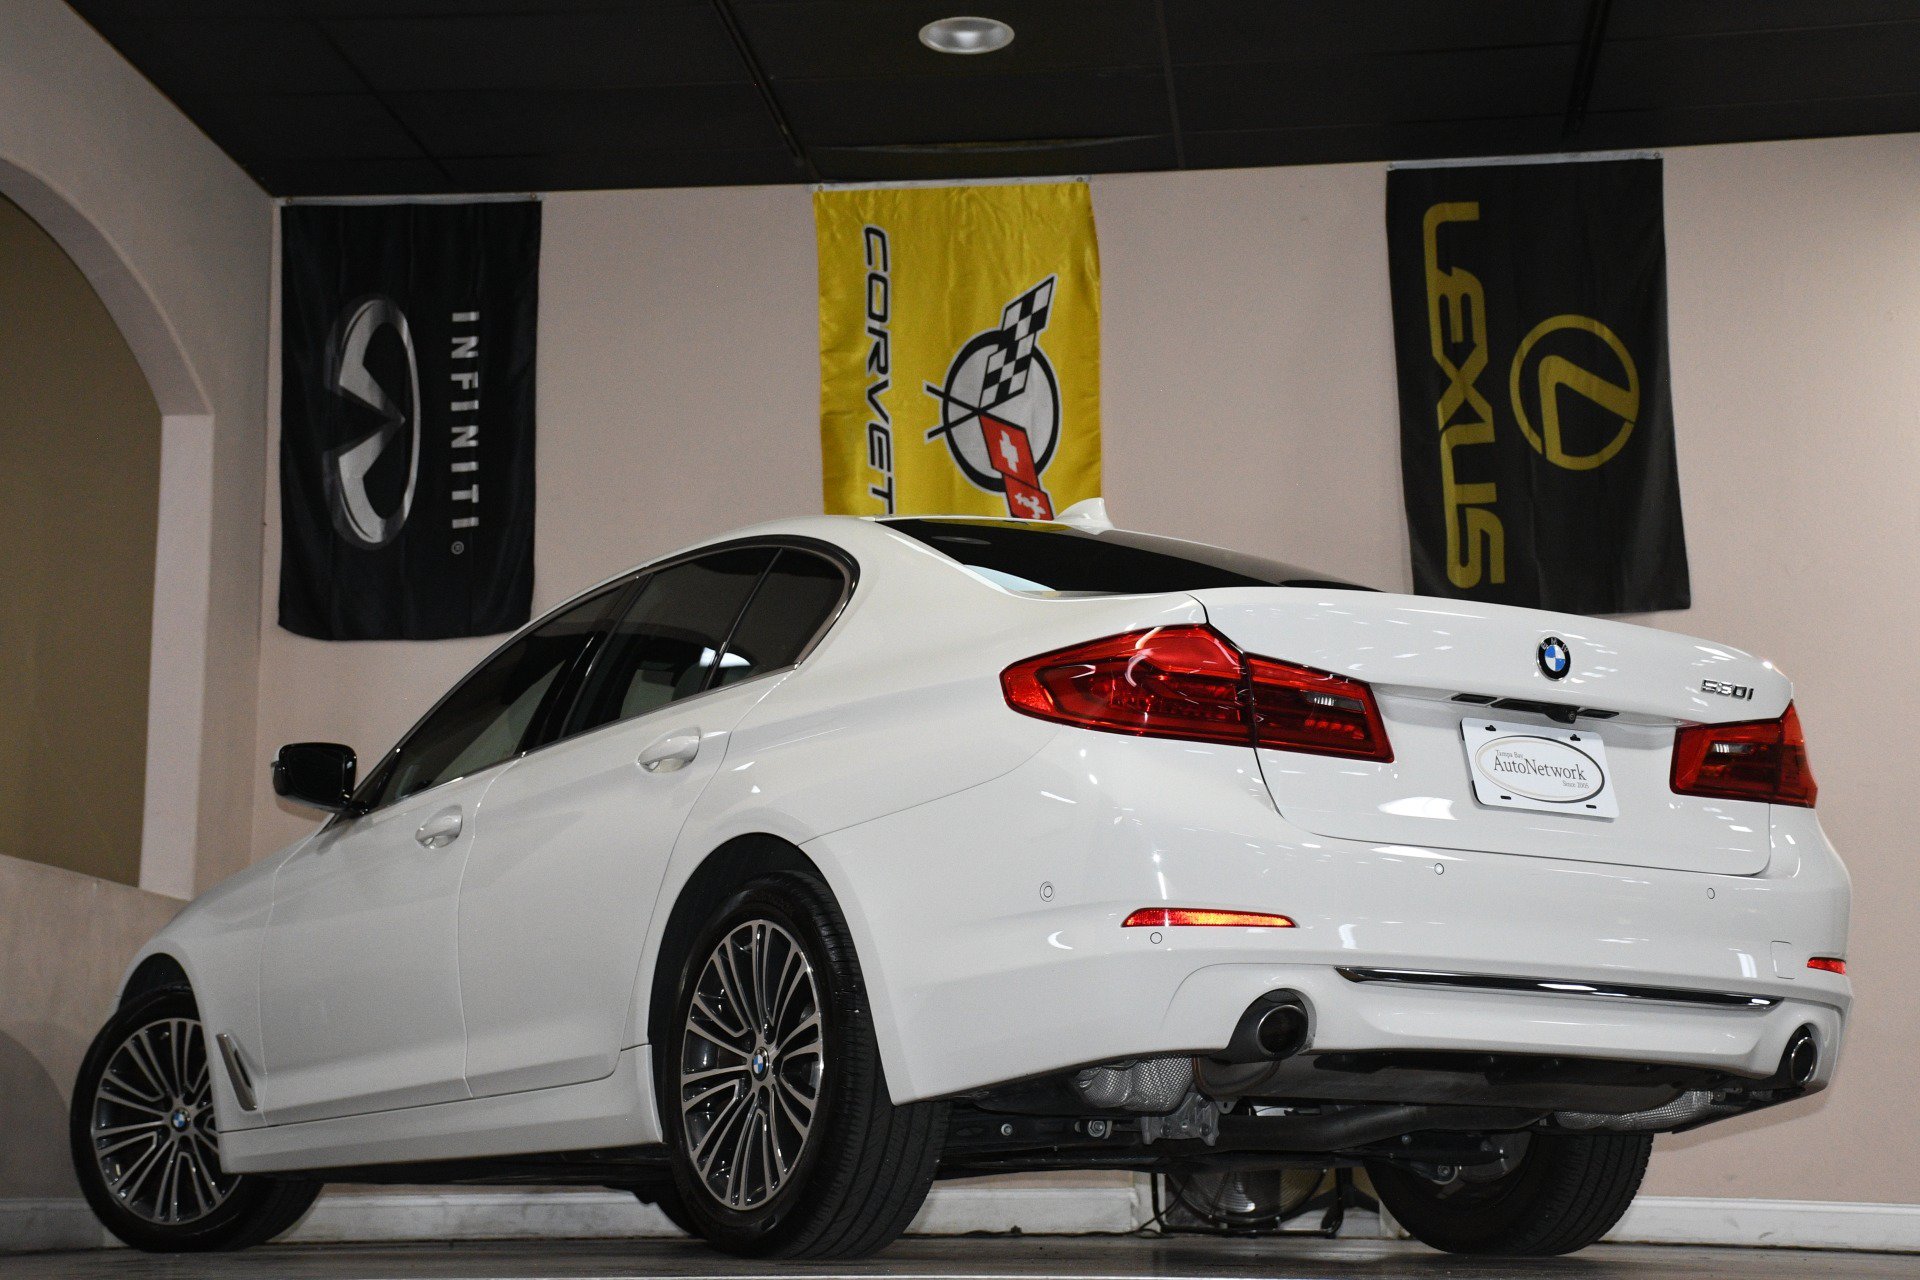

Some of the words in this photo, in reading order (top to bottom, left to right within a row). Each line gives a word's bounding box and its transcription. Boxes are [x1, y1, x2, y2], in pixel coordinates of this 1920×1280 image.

[450, 311, 480, 529] INFINITI
[1423, 201, 1505, 589] LEXUS
[1494, 755, 1587, 780] AutoNetwork
[1496, 750, 1513, 759] Tampa
[1513, 751, 1524, 759] Bay
